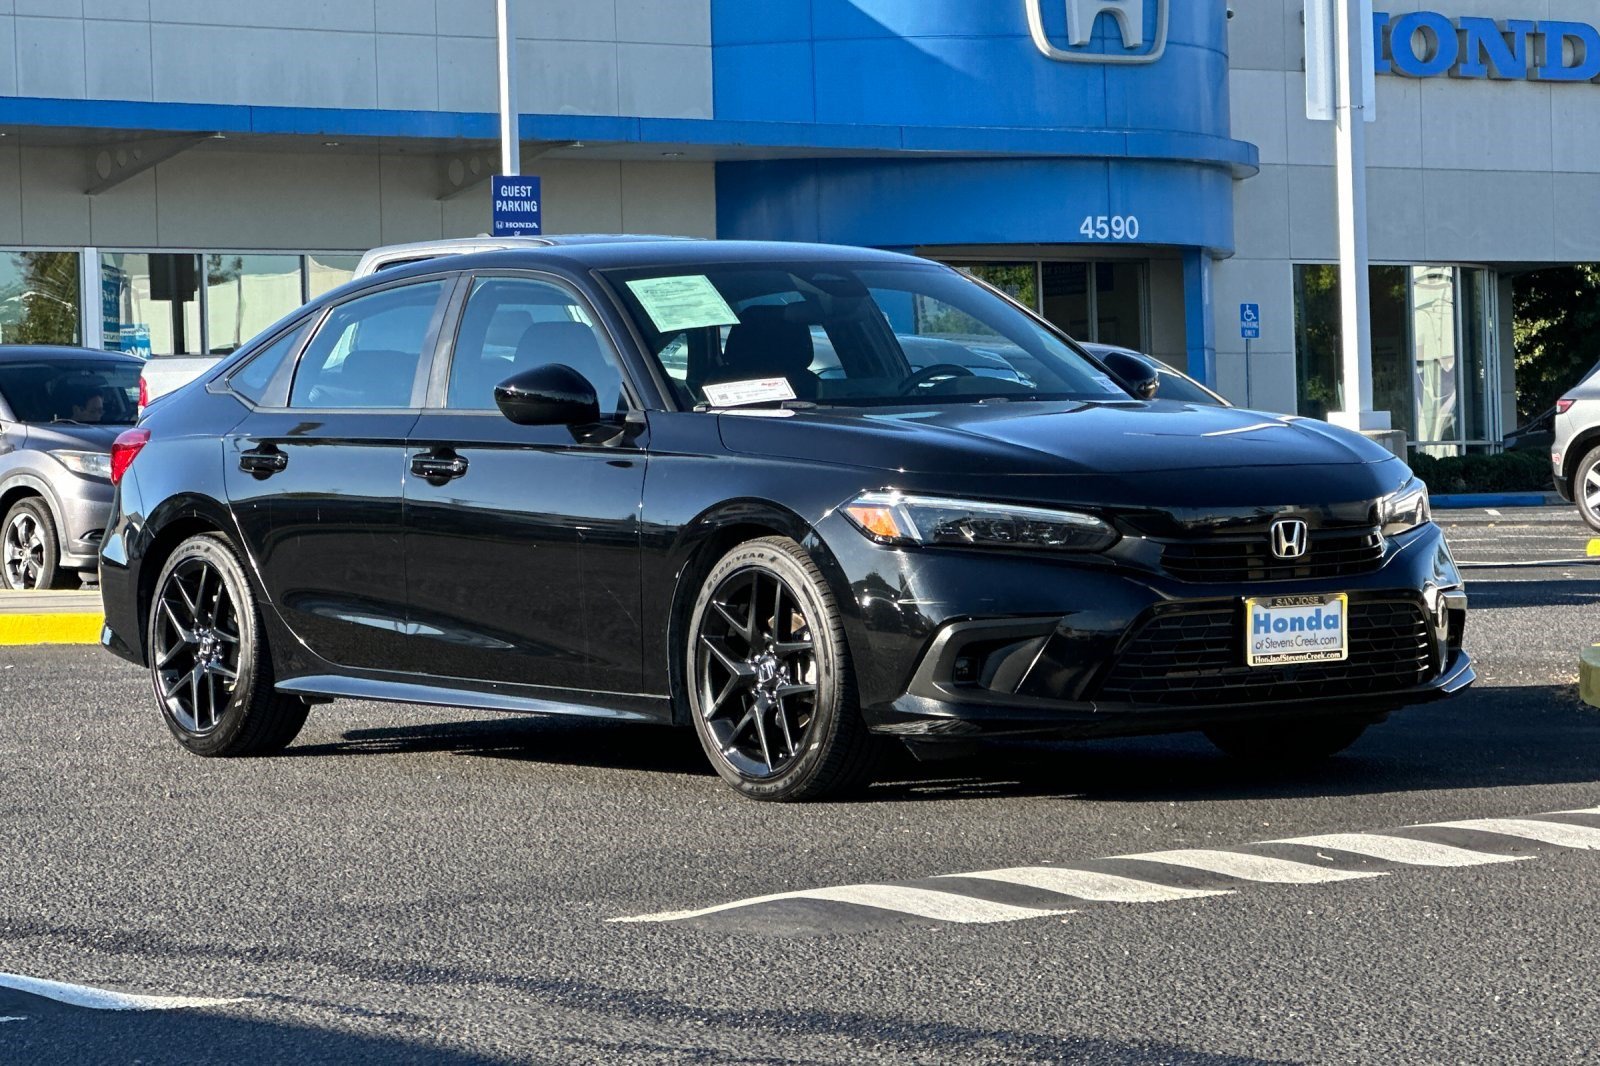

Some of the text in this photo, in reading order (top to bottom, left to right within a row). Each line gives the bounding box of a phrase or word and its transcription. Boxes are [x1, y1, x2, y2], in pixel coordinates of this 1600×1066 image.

[1373, 11, 1600, 81] OND
[501, 185, 532, 197] GUEST
[496, 200, 538, 212] PARKING
[505, 221, 539, 229] HONDA
[1080, 215, 1139, 239] 4590
[1276, 596, 1319, 606] SAN JOSE
[1253, 608, 1339, 634] Honda
[1255, 633, 1337, 649] of Stevens Creek.com
